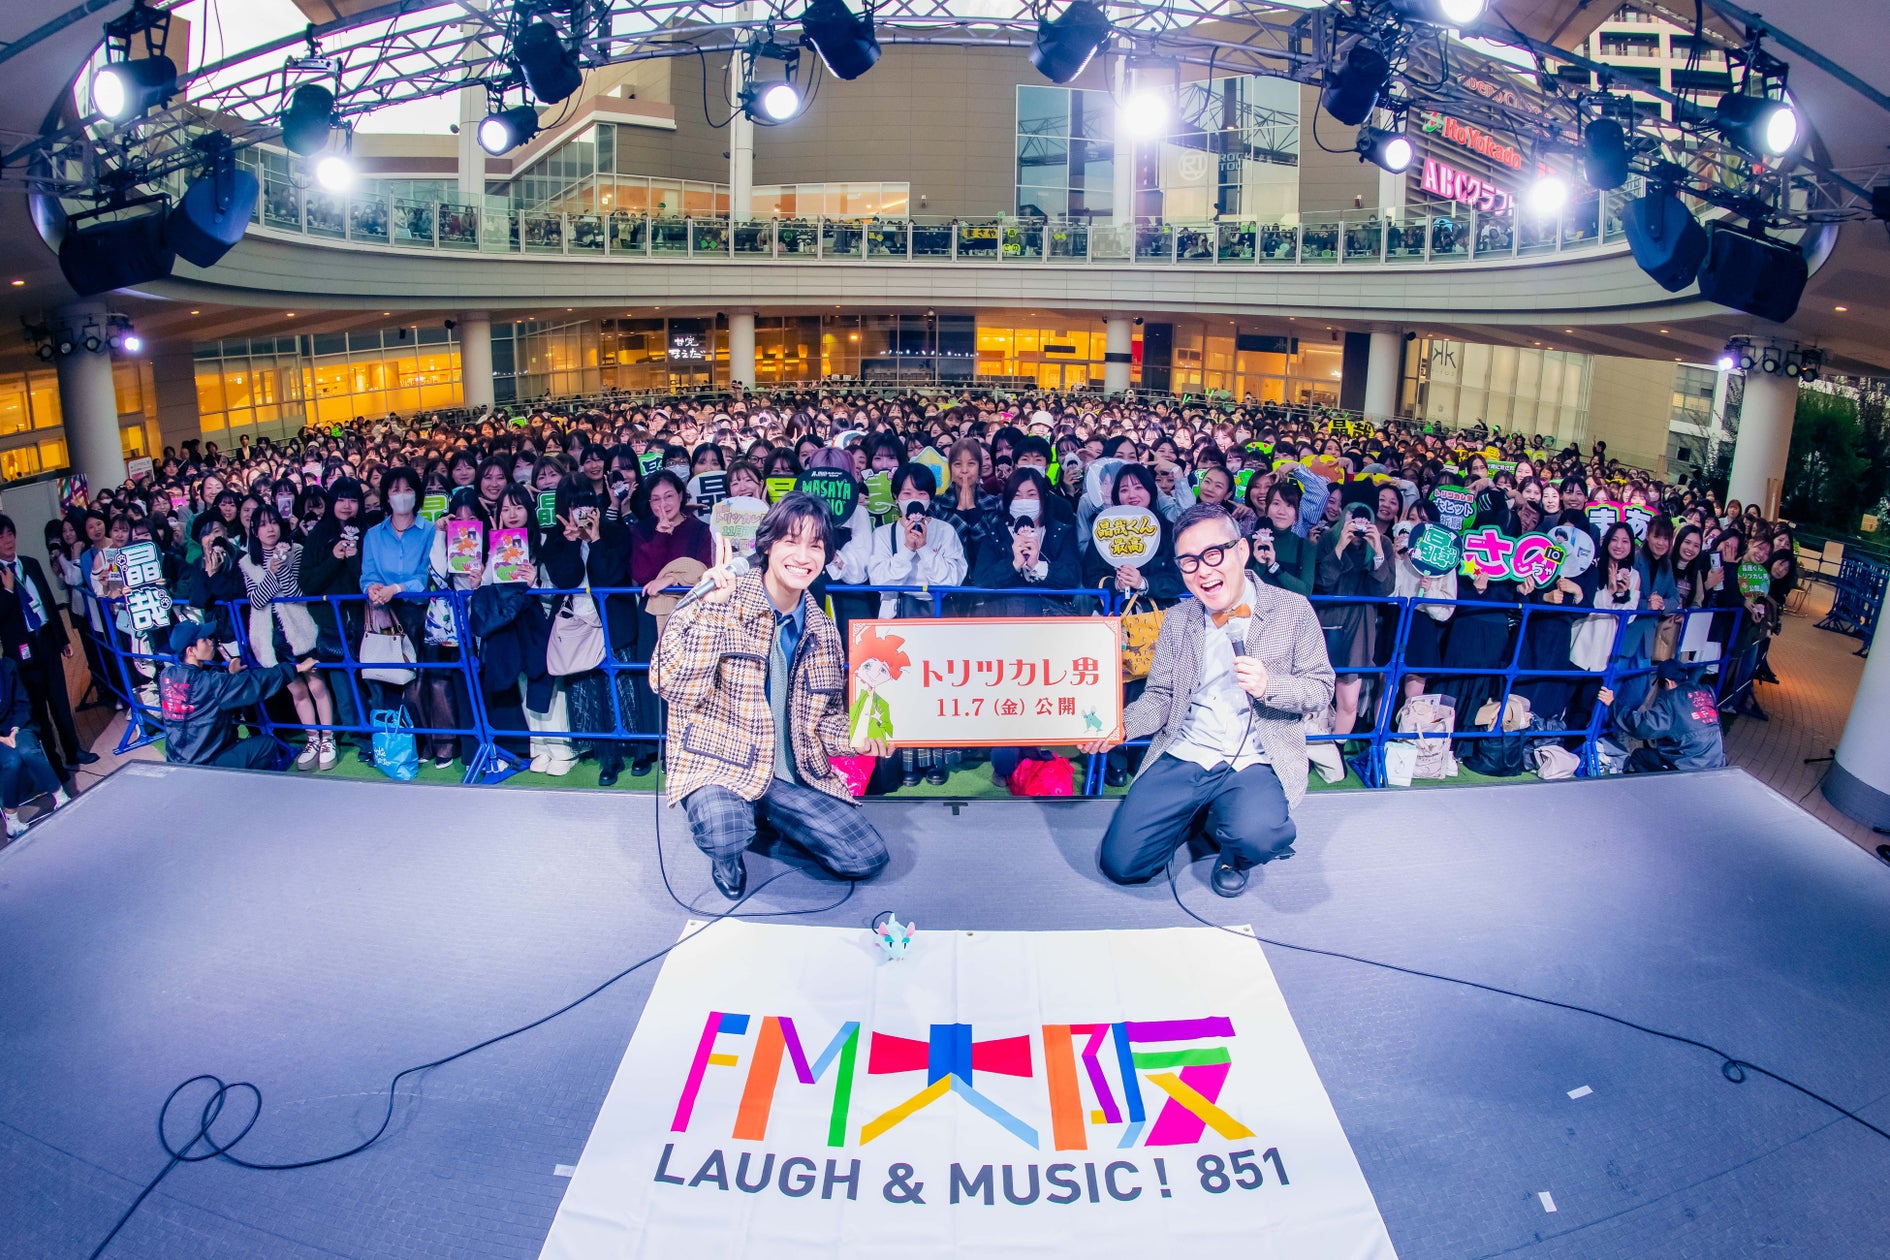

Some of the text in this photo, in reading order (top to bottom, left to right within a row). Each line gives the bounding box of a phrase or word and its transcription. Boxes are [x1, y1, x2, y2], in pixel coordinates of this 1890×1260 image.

[1444, 116, 1522, 170] ItoYokado
[802, 480, 851, 500] MASAYA
[1110, 537, 1146, 556] 最高
[922, 656, 1100, 688] トリツカレ男
[653, 1143, 862, 1201] LAUGH
[882, 1162, 927, 1205] &
[1200, 1146, 1291, 1194] 851
